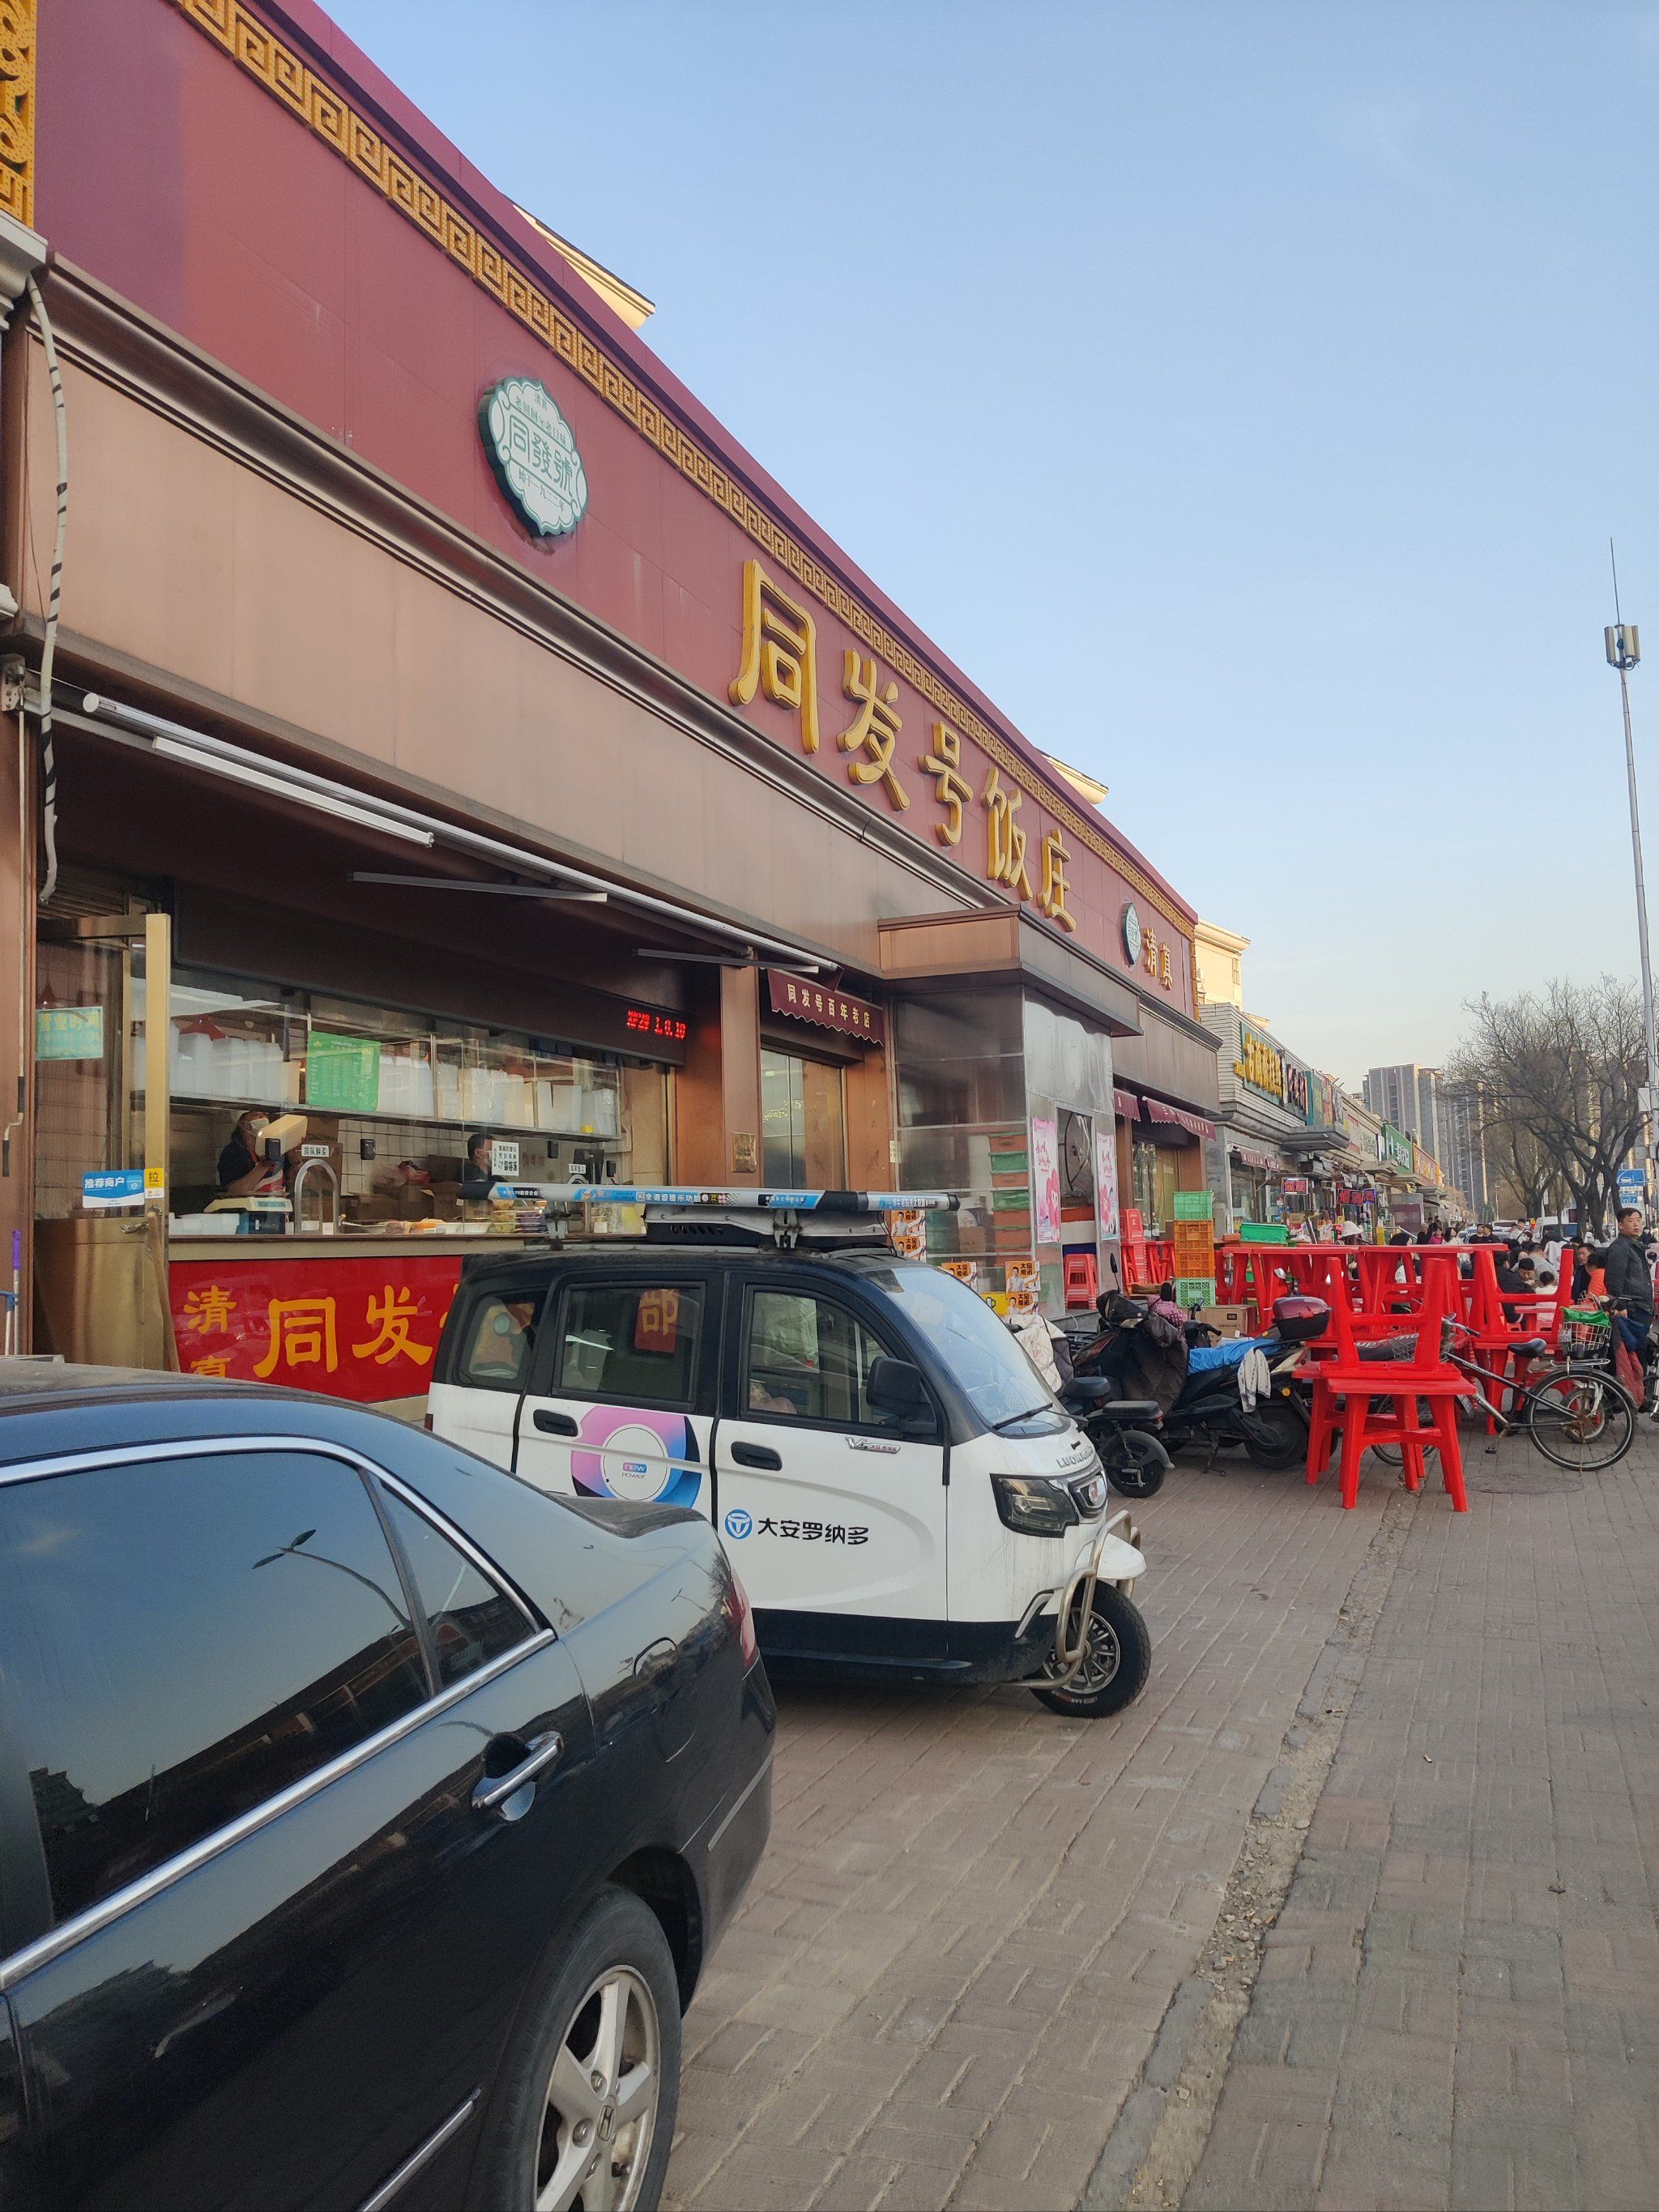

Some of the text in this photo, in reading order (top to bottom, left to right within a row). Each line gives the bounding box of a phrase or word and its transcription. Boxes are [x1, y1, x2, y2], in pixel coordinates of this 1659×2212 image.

[728, 559, 1077, 933] 同发号饭庄
[1143, 927, 1173, 991] 清真
[787, 983, 871, 1029] 同发号百年老店
[84, 1177, 125, 1188] 推荐商户
[149, 1171, 160, 1183] 拉
[253, 1284, 460, 1378] 同发
[757, 1517, 869, 1545] 大安罗纳多
